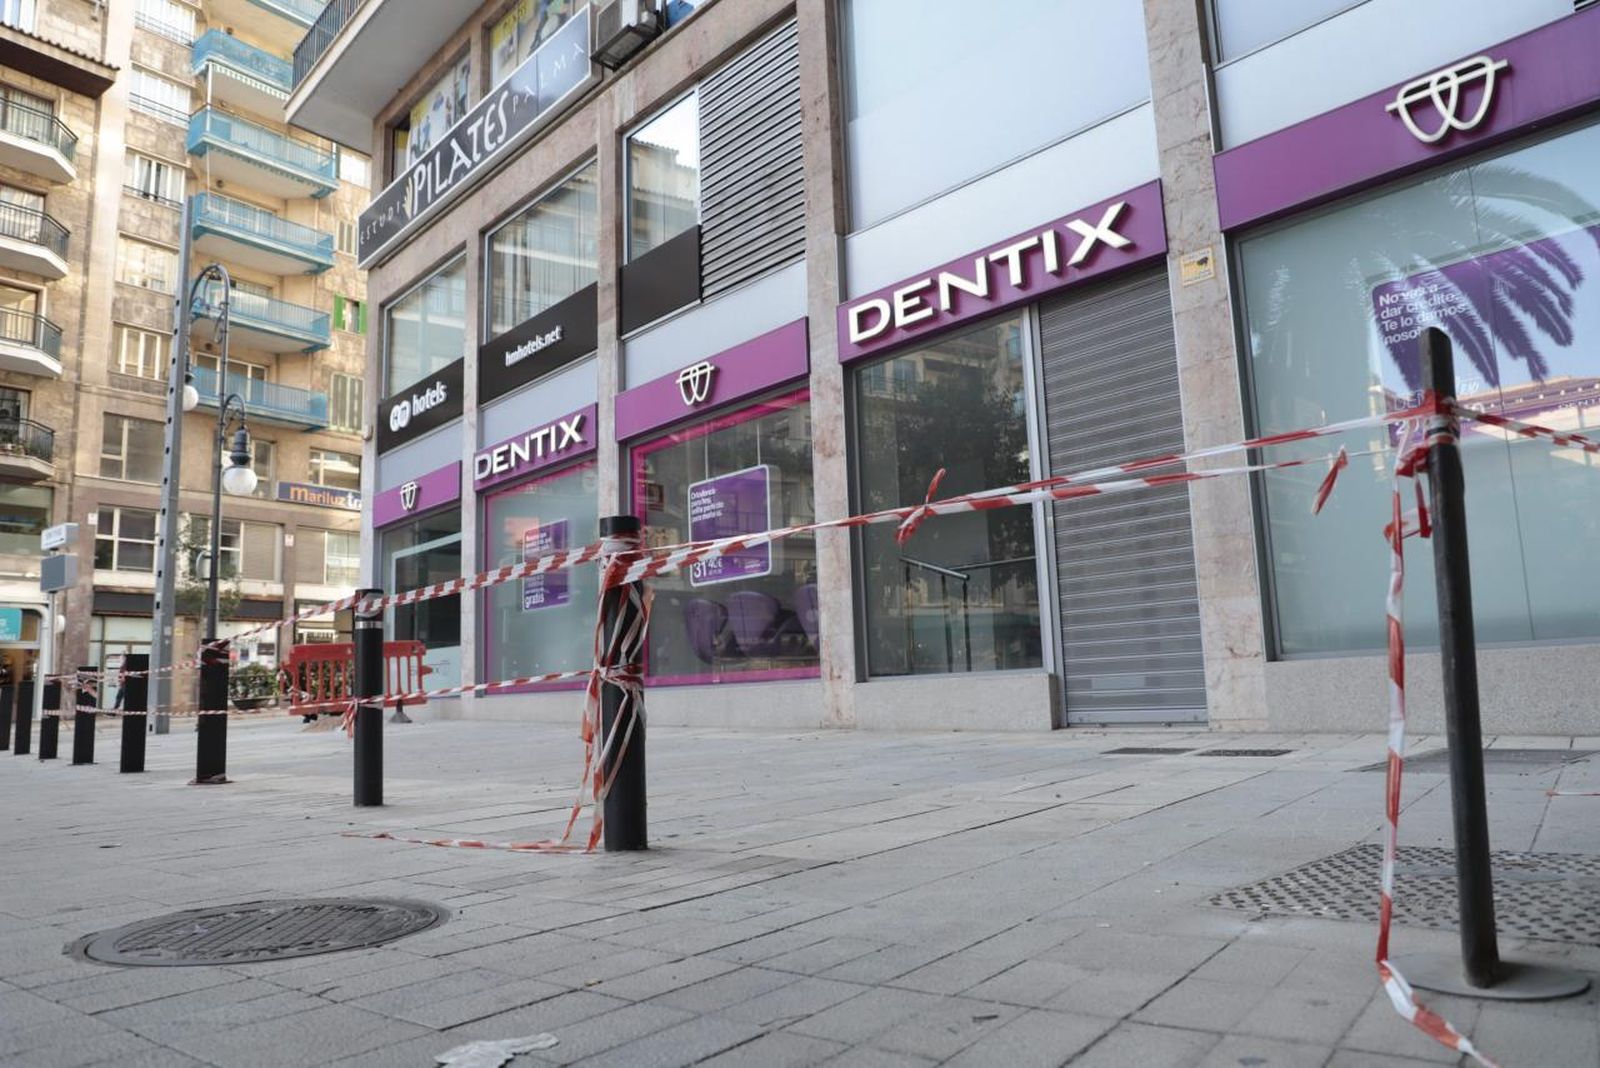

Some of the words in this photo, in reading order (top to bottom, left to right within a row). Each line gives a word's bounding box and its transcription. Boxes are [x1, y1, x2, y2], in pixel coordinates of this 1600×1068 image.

[413, 91, 508, 217] PILATES
[513, 42, 585, 113] PALMA
[848, 200, 1133, 346] DENTIX
[1379, 293, 1399, 306] No
[1381, 306, 1403, 319] dar
[1382, 319, 1398, 331] Te
[1401, 316, 1413, 327] lo
[412, 381, 448, 416] hotels
[474, 414, 583, 480] DENTIX
[289, 486, 346, 506] mariluz
